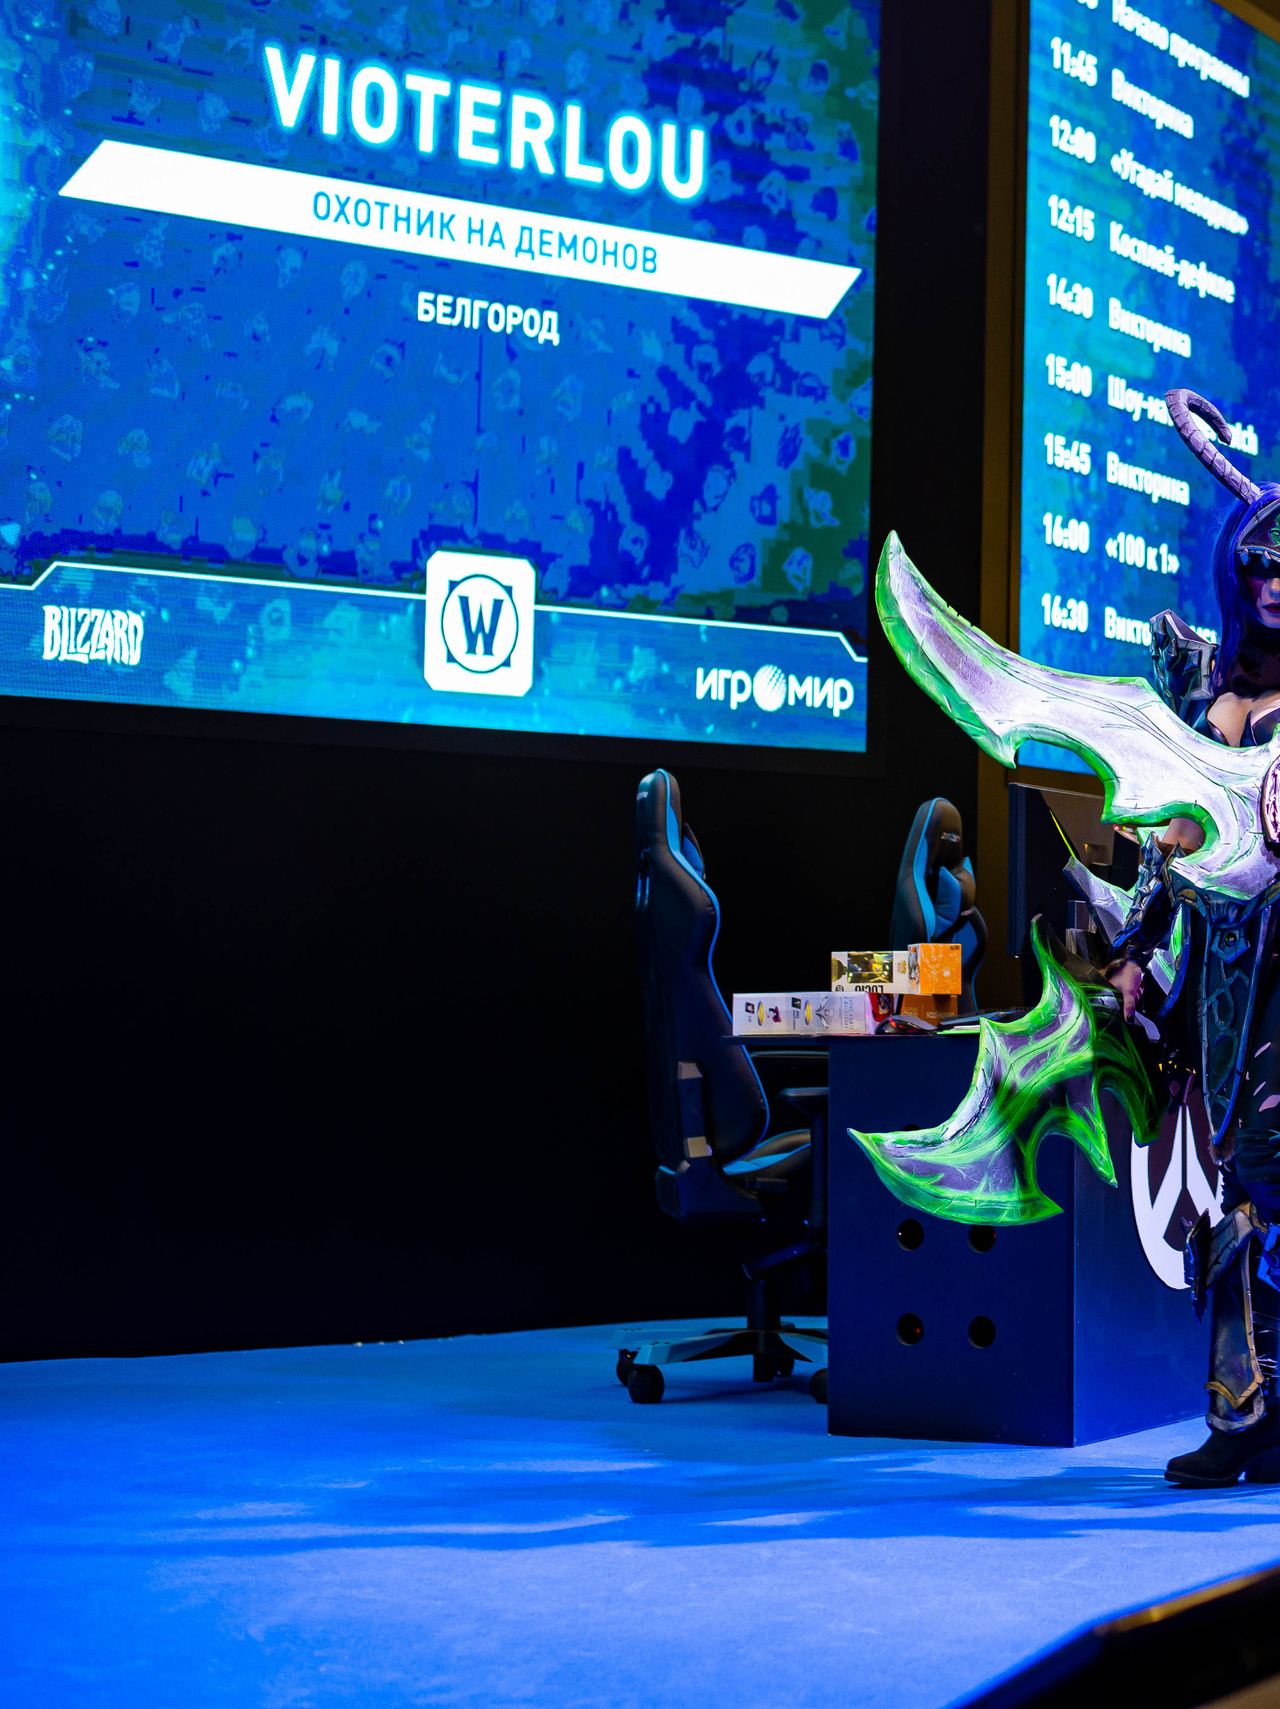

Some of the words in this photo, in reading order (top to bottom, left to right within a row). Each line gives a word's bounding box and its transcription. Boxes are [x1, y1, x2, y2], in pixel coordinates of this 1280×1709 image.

[1051, 37, 1097, 86] 11:45
[264, 46, 705, 199] VIOTERLOU
[1111, 68, 1193, 138] Викторина
[312, 191, 456, 242] ОХОТНИК
[467, 216, 506, 250] НА
[514, 226, 658, 274] ДЕМОНОВ
[1049, 194, 1095, 241] 12:15
[1109, 221, 1235, 303] Косплей-дефиле
[417, 292, 560, 346] БЕЛГОРОД
[1047, 273, 1093, 318] 14:30
[1109, 297, 1191, 357] Викторина
[1045, 353, 1092, 397] 15:00
[1108, 375, 1174, 427] Шоу-ма
[1044, 433, 1091, 475] 15:45
[1107, 451, 1190, 505] Викторина
[1043, 512, 1090, 553] 16:00
[1105, 532, 1145, 568] «100
[1159, 543, 1179, 574] 1»
[43, 605, 144, 666] BLIZZARD
[1042, 593, 1088, 633] 16:30
[1104, 606, 1151, 646] Викто
